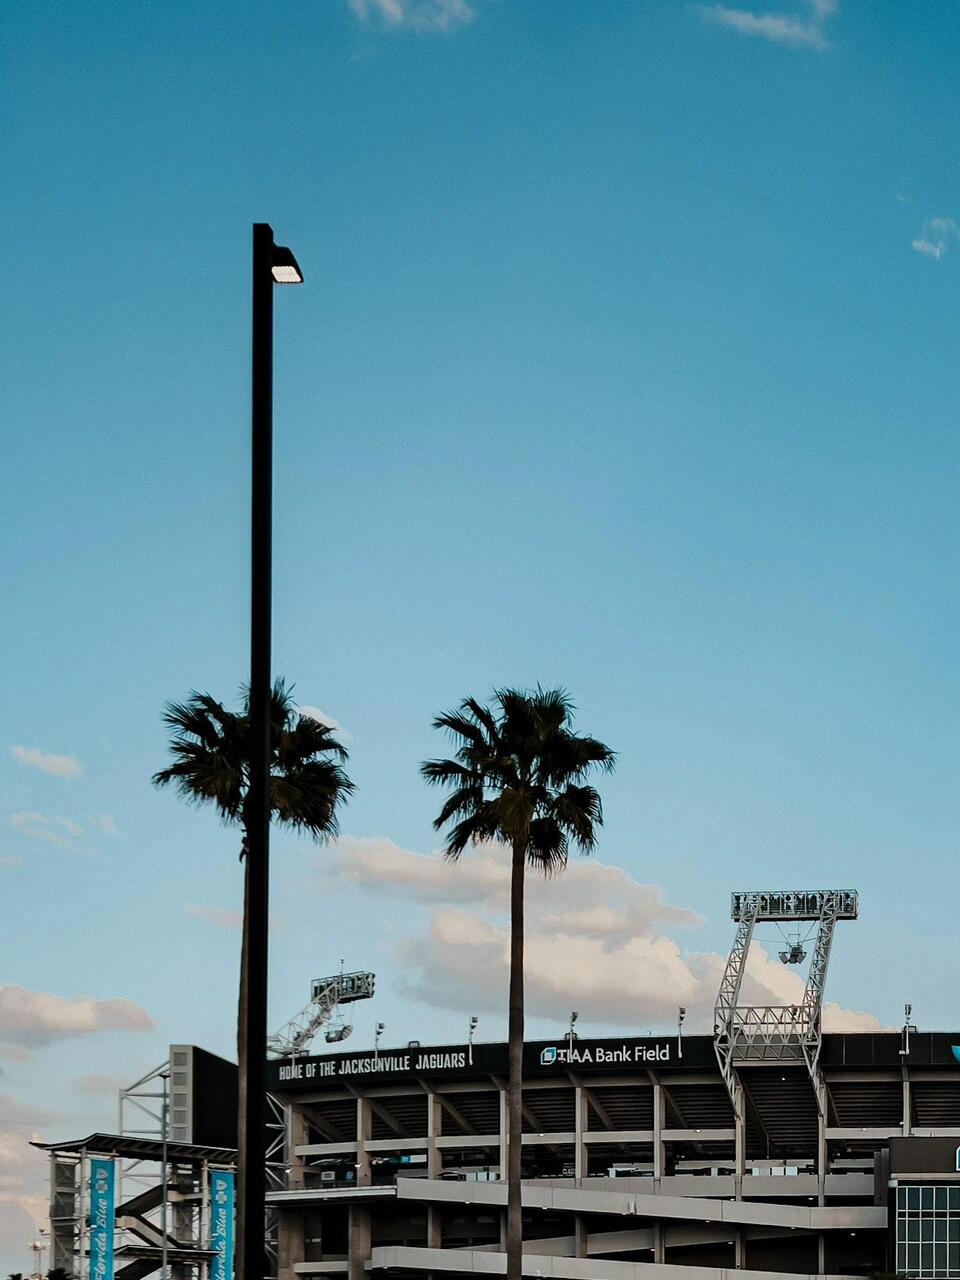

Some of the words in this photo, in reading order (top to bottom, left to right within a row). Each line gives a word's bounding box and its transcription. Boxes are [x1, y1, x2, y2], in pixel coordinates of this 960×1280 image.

[279, 1064, 303, 1081] HOME
[305, 1063, 316, 1078] OF
[319, 1061, 336, 1077] THE
[338, 1055, 411, 1075] JACKSONVILLE
[415, 1052, 466, 1070] JAGUARS
[557, 1048, 593, 1063] TIAA
[595, 1045, 632, 1062] Bank
[634, 1044, 670, 1061] Field
[95, 1198, 108, 1229] Blue
[215, 1207, 228, 1237] Blue
